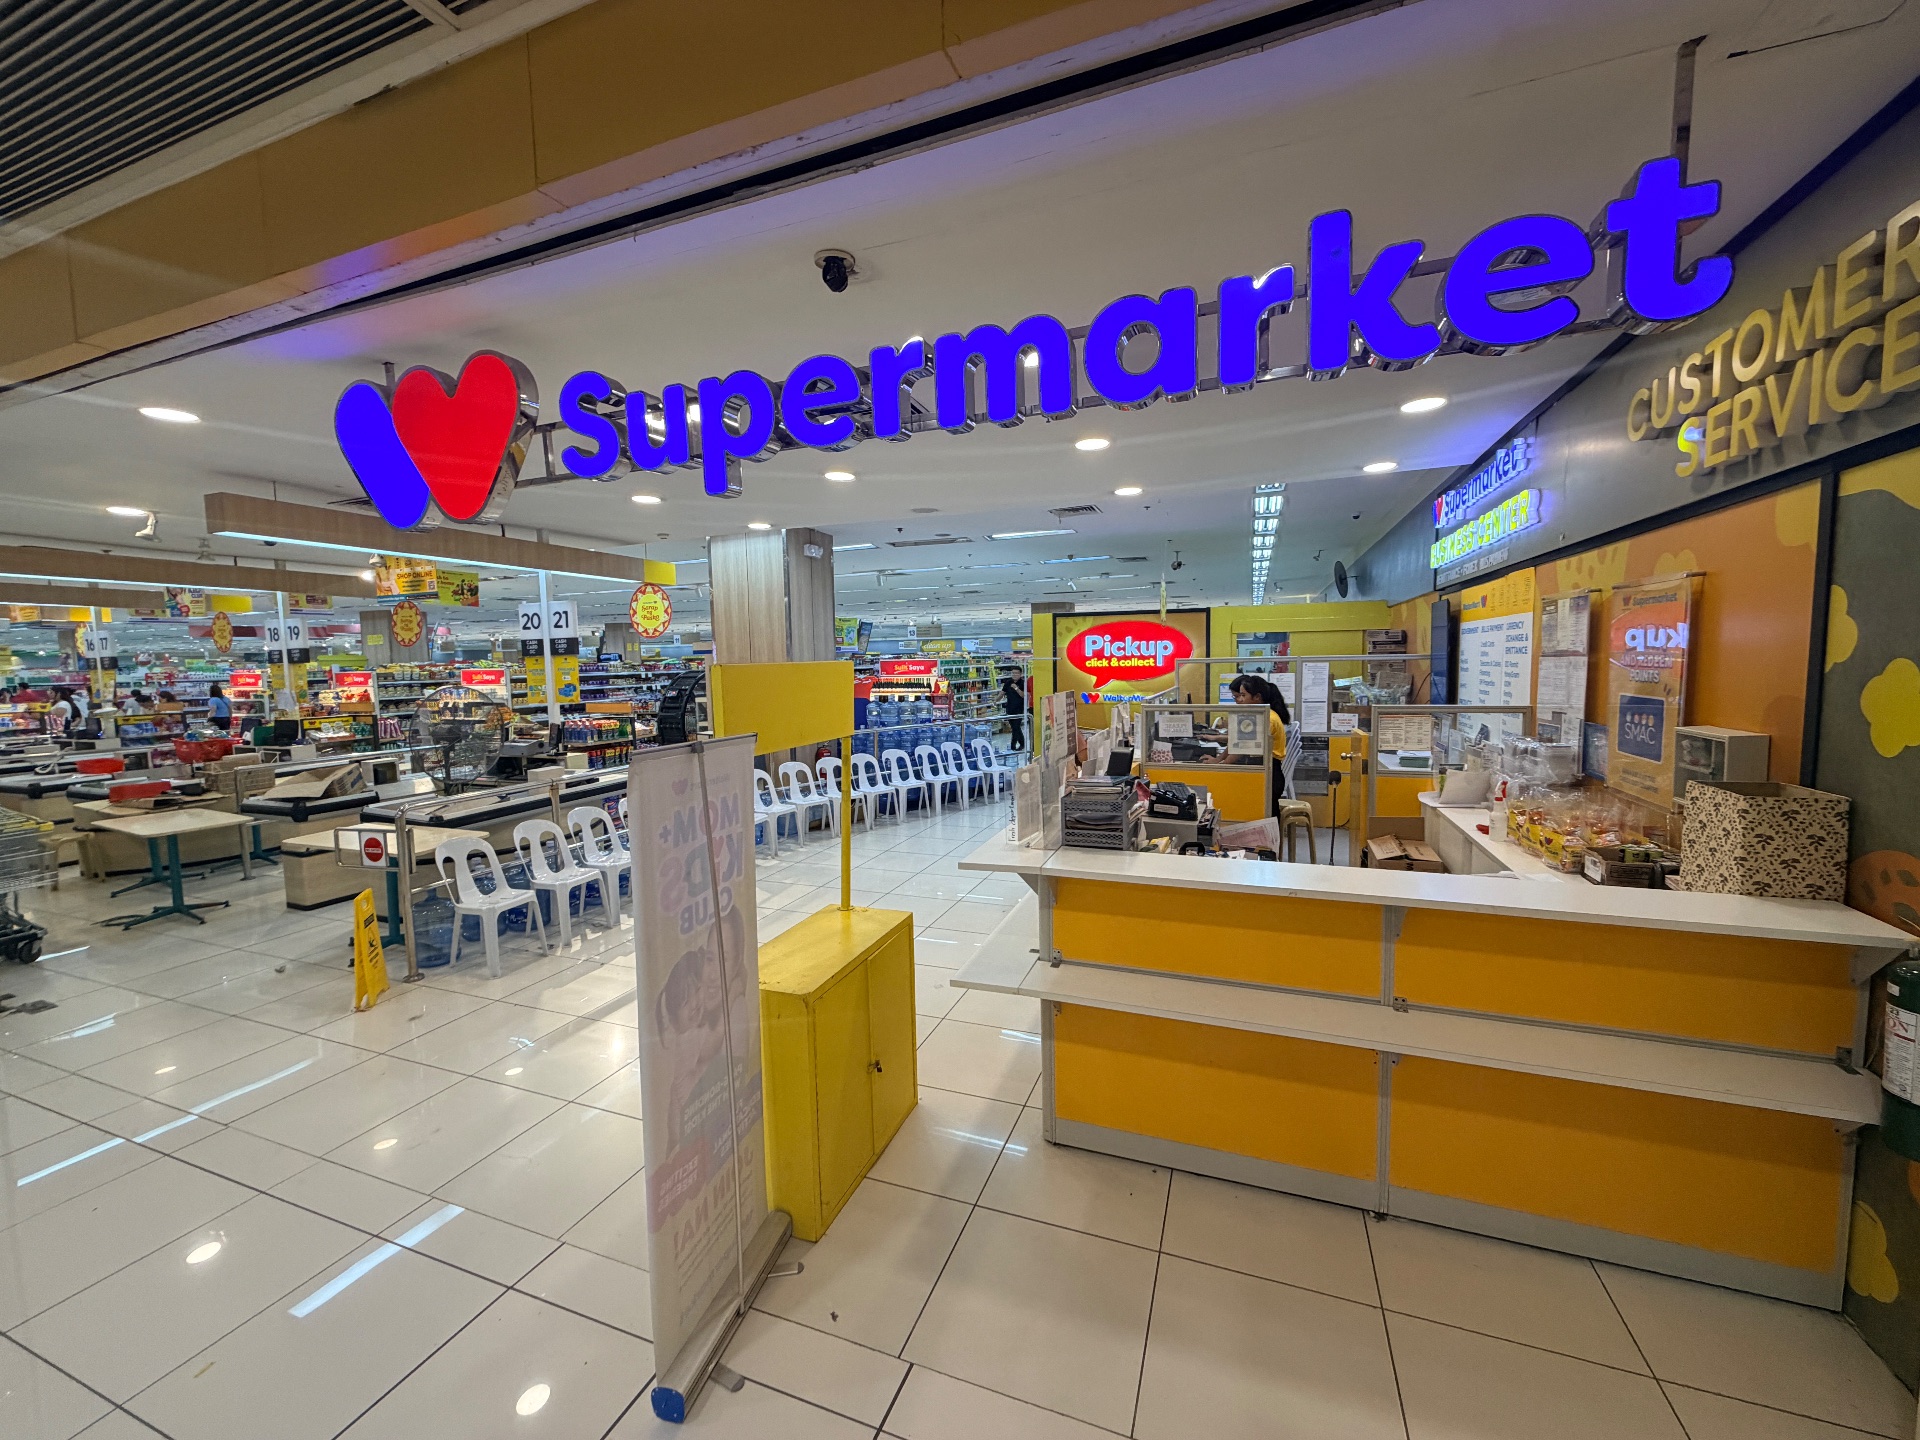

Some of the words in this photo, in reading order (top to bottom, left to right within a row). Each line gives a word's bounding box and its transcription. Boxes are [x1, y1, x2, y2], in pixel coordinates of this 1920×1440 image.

[558, 157, 1735, 500] Supermarket
[1627, 200, 1920, 443] CUSTOMER
[1675, 297, 1920, 478] SERVICE
[1443, 437, 1528, 520] Supermarket
[1430, 520, 1476, 569] BUSINESS
[1476, 489, 1534, 547] CENTER
[396, 572, 412, 580] SHOP
[413, 570, 433, 579] ONLINE
[521, 612, 541, 630] 20
[552, 610, 569, 629] 21
[267, 627, 280, 642] 18
[287, 625, 300, 641] 19
[908, 629, 916, 637] 13
[85, 639, 95, 651] 16
[99, 637, 108, 650] 17
[941, 641, 952, 651] up
[1085, 634, 1174, 666] Pickup
[1085, 658, 1109, 668] click
[1110, 657, 1118, 667] &
[1119, 658, 1155, 668] collect
[1620, 654, 1636, 666] AND
[909, 664, 925, 672] Saya
[1629, 669, 1661, 683] POINTS
[1624, 722, 1656, 745] SMAC
